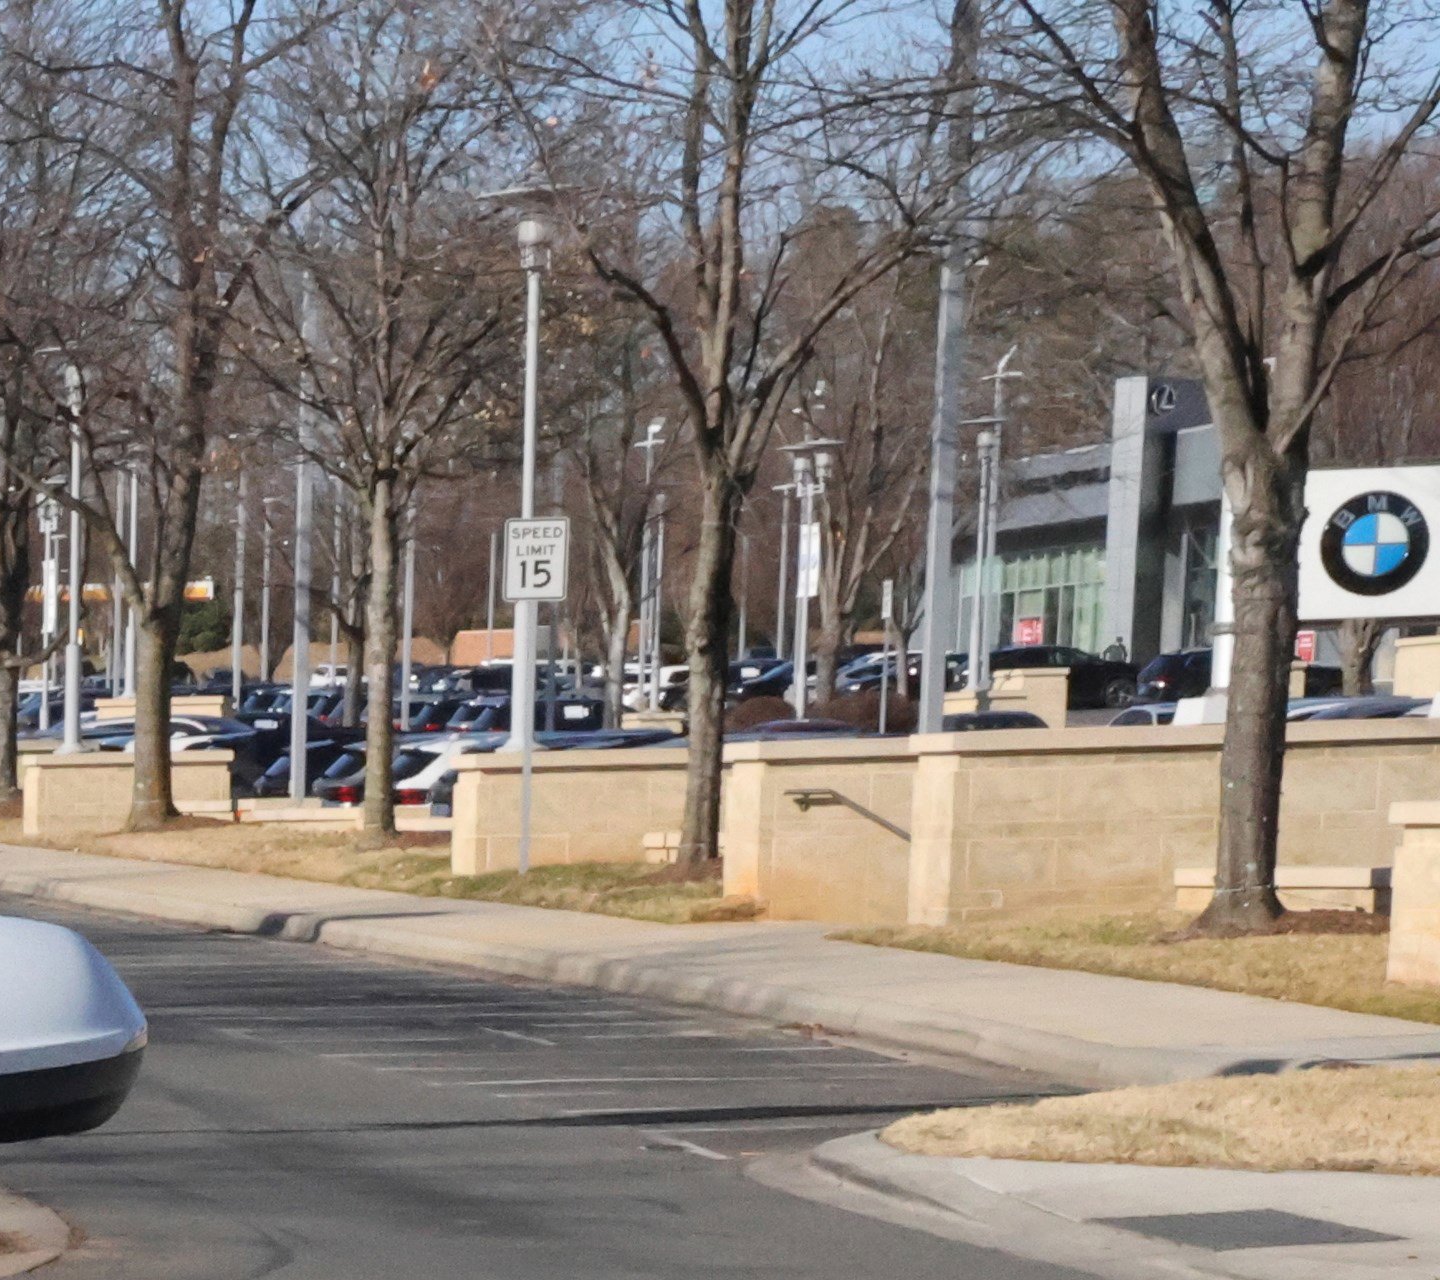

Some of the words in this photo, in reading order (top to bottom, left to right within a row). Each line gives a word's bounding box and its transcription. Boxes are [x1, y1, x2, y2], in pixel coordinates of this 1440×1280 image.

[1332, 494, 1423, 530] BMW
[511, 526, 564, 540] SPEED
[515, 544, 556, 557] LIMIT
[520, 559, 552, 589] 15
